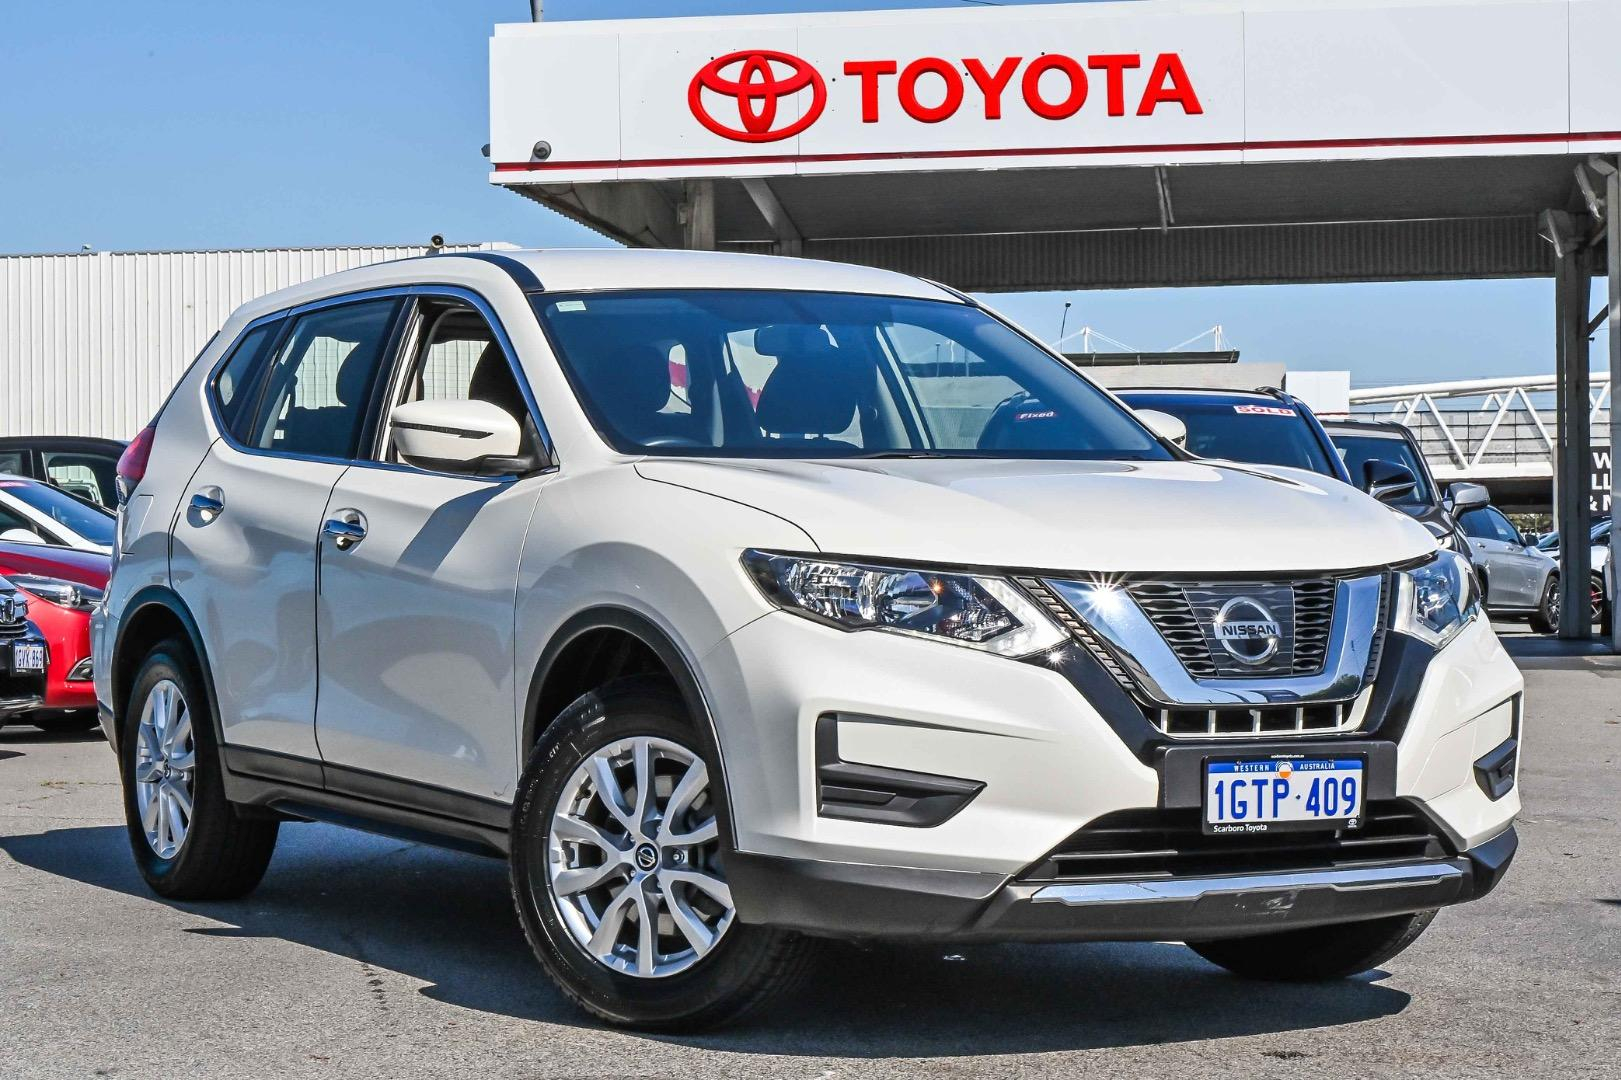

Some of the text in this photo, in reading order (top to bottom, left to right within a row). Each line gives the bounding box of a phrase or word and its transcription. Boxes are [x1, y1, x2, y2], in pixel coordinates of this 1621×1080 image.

[844, 53, 1204, 123] TOYOTA
[1238, 405, 1293, 415] SOLD
[1222, 624, 1277, 636] NISSAN
[1234, 762, 1335, 772] WESTERN AUSTRALIA
[1213, 823, 1268, 833] Scarboro Toyota
